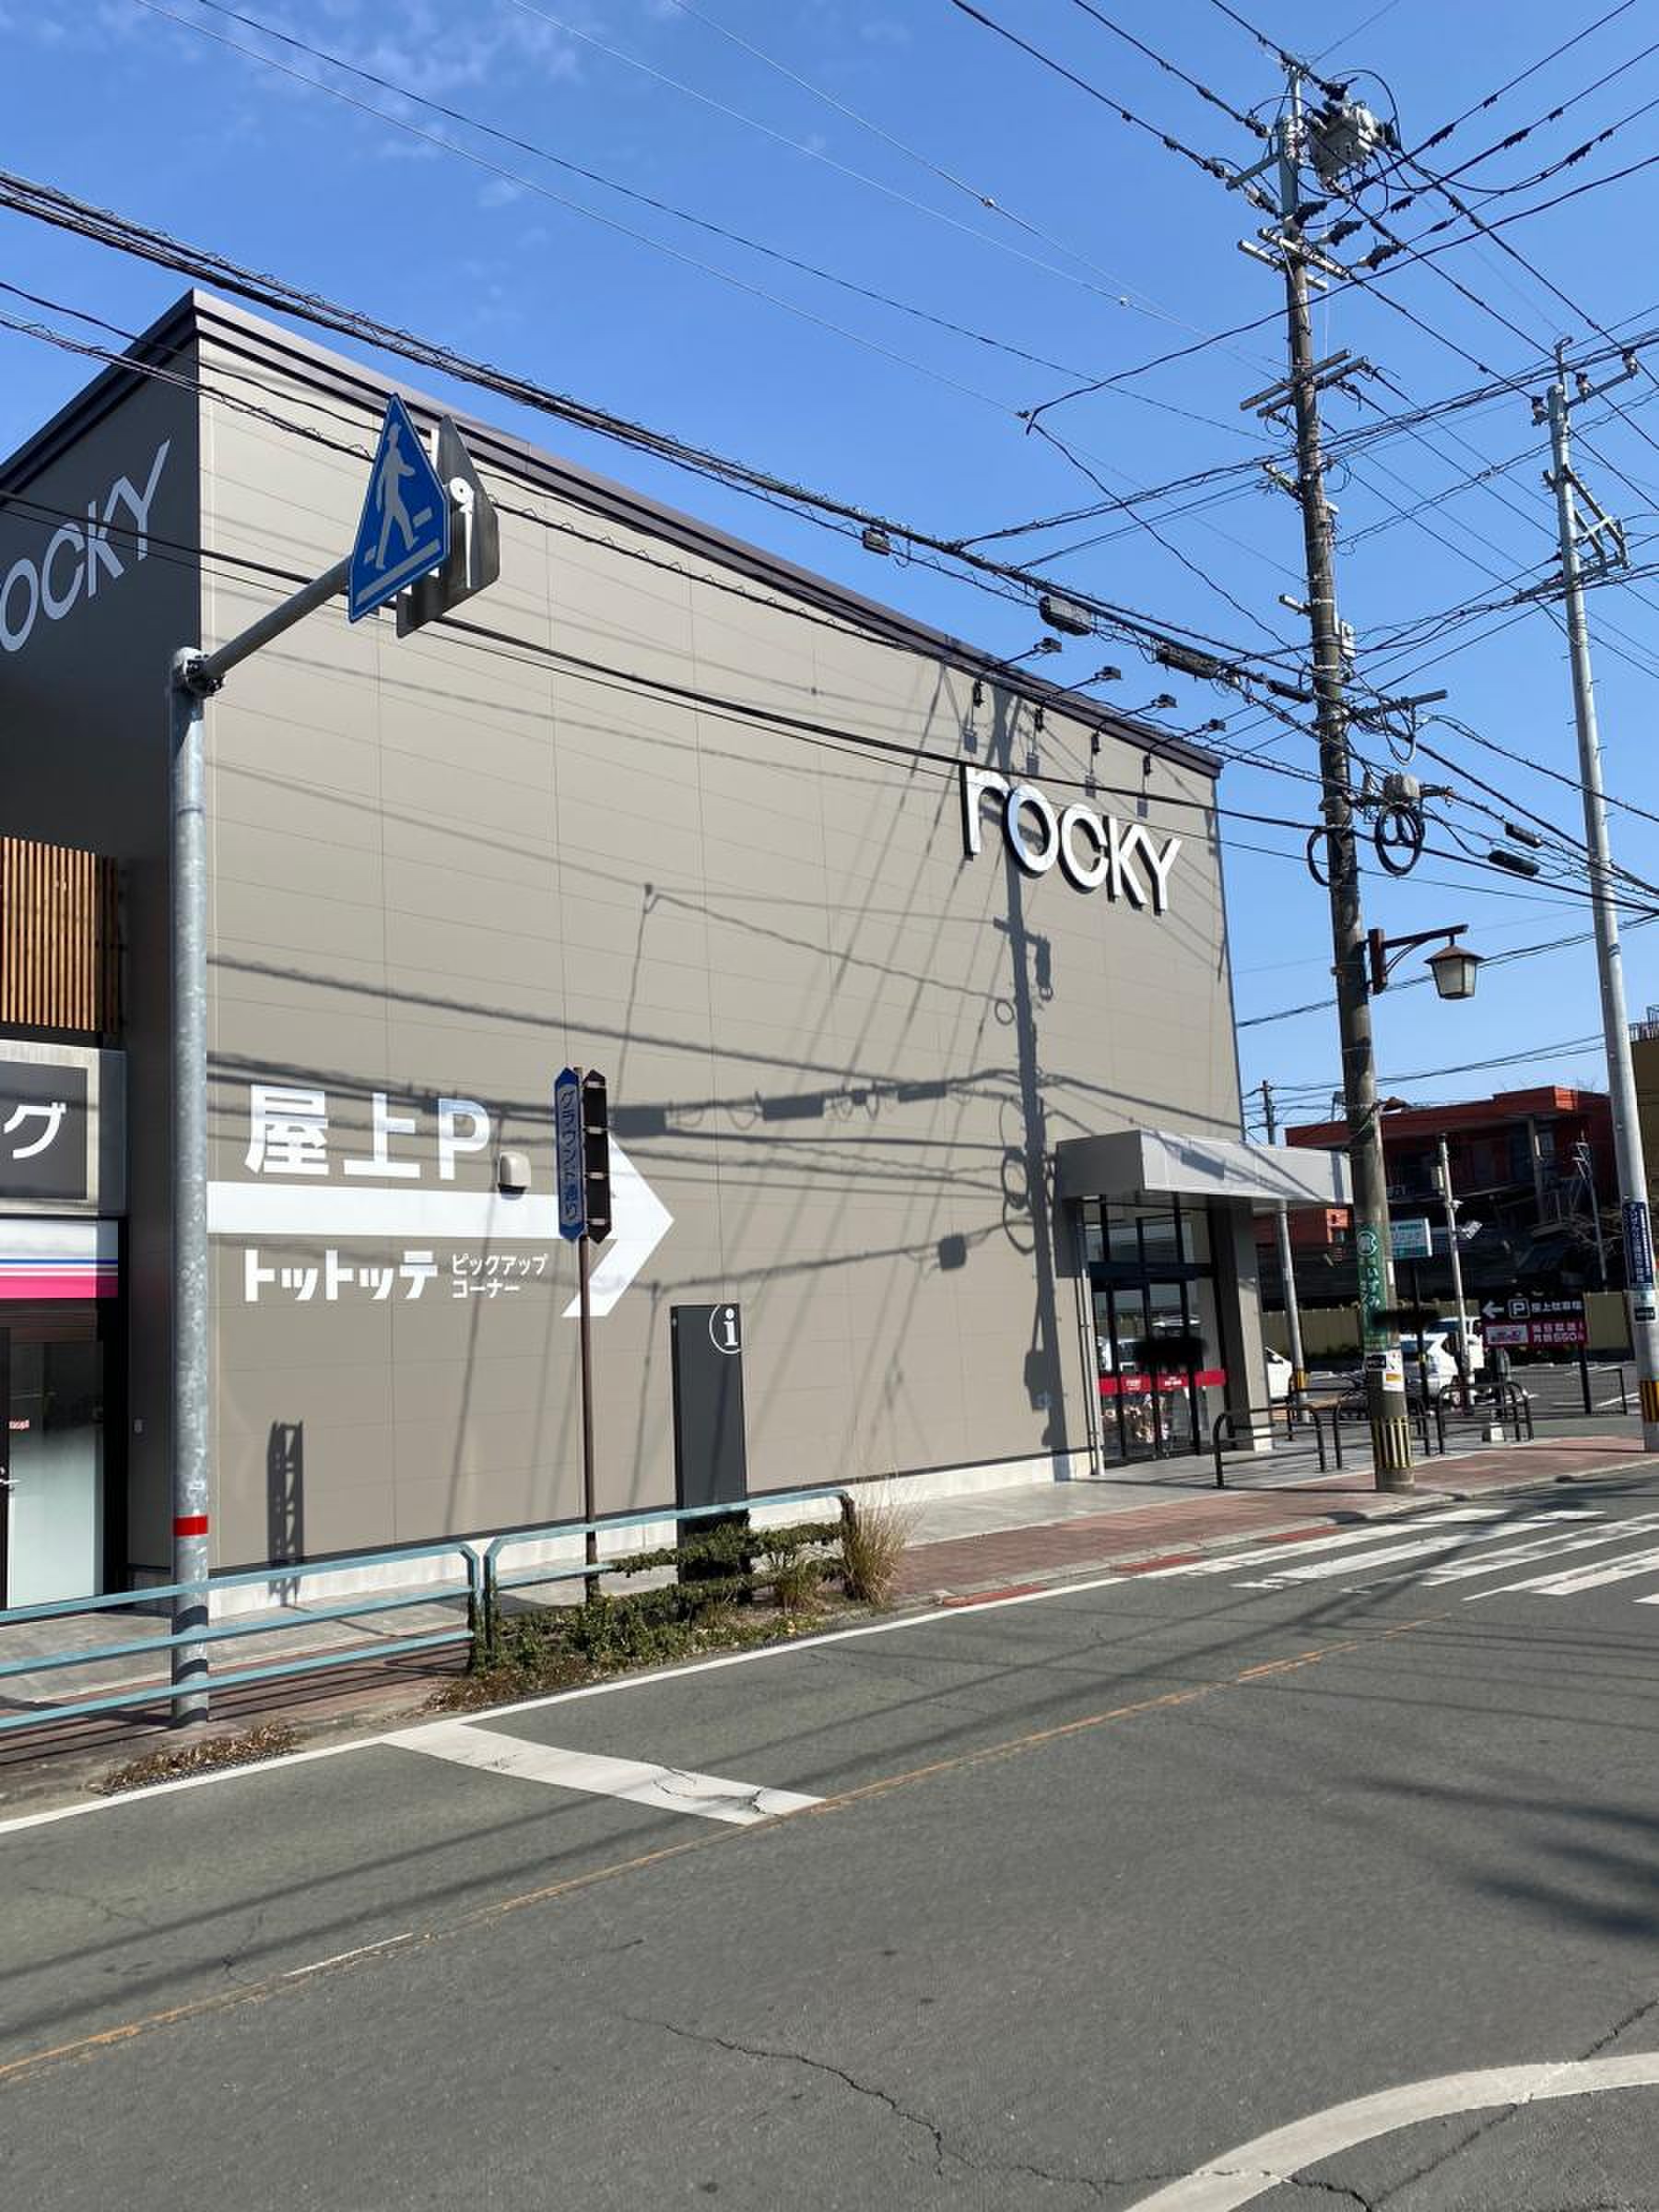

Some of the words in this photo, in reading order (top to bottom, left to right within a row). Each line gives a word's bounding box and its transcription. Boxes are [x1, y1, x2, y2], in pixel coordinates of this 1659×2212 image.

[0, 440, 171, 652] OCKY
[244, 1084, 491, 1181] 屋上P
[244, 1249, 439, 1302] トットッテ
[452, 1253, 549, 1277] ピックアップ
[452, 1278, 521, 1299] コーナー
